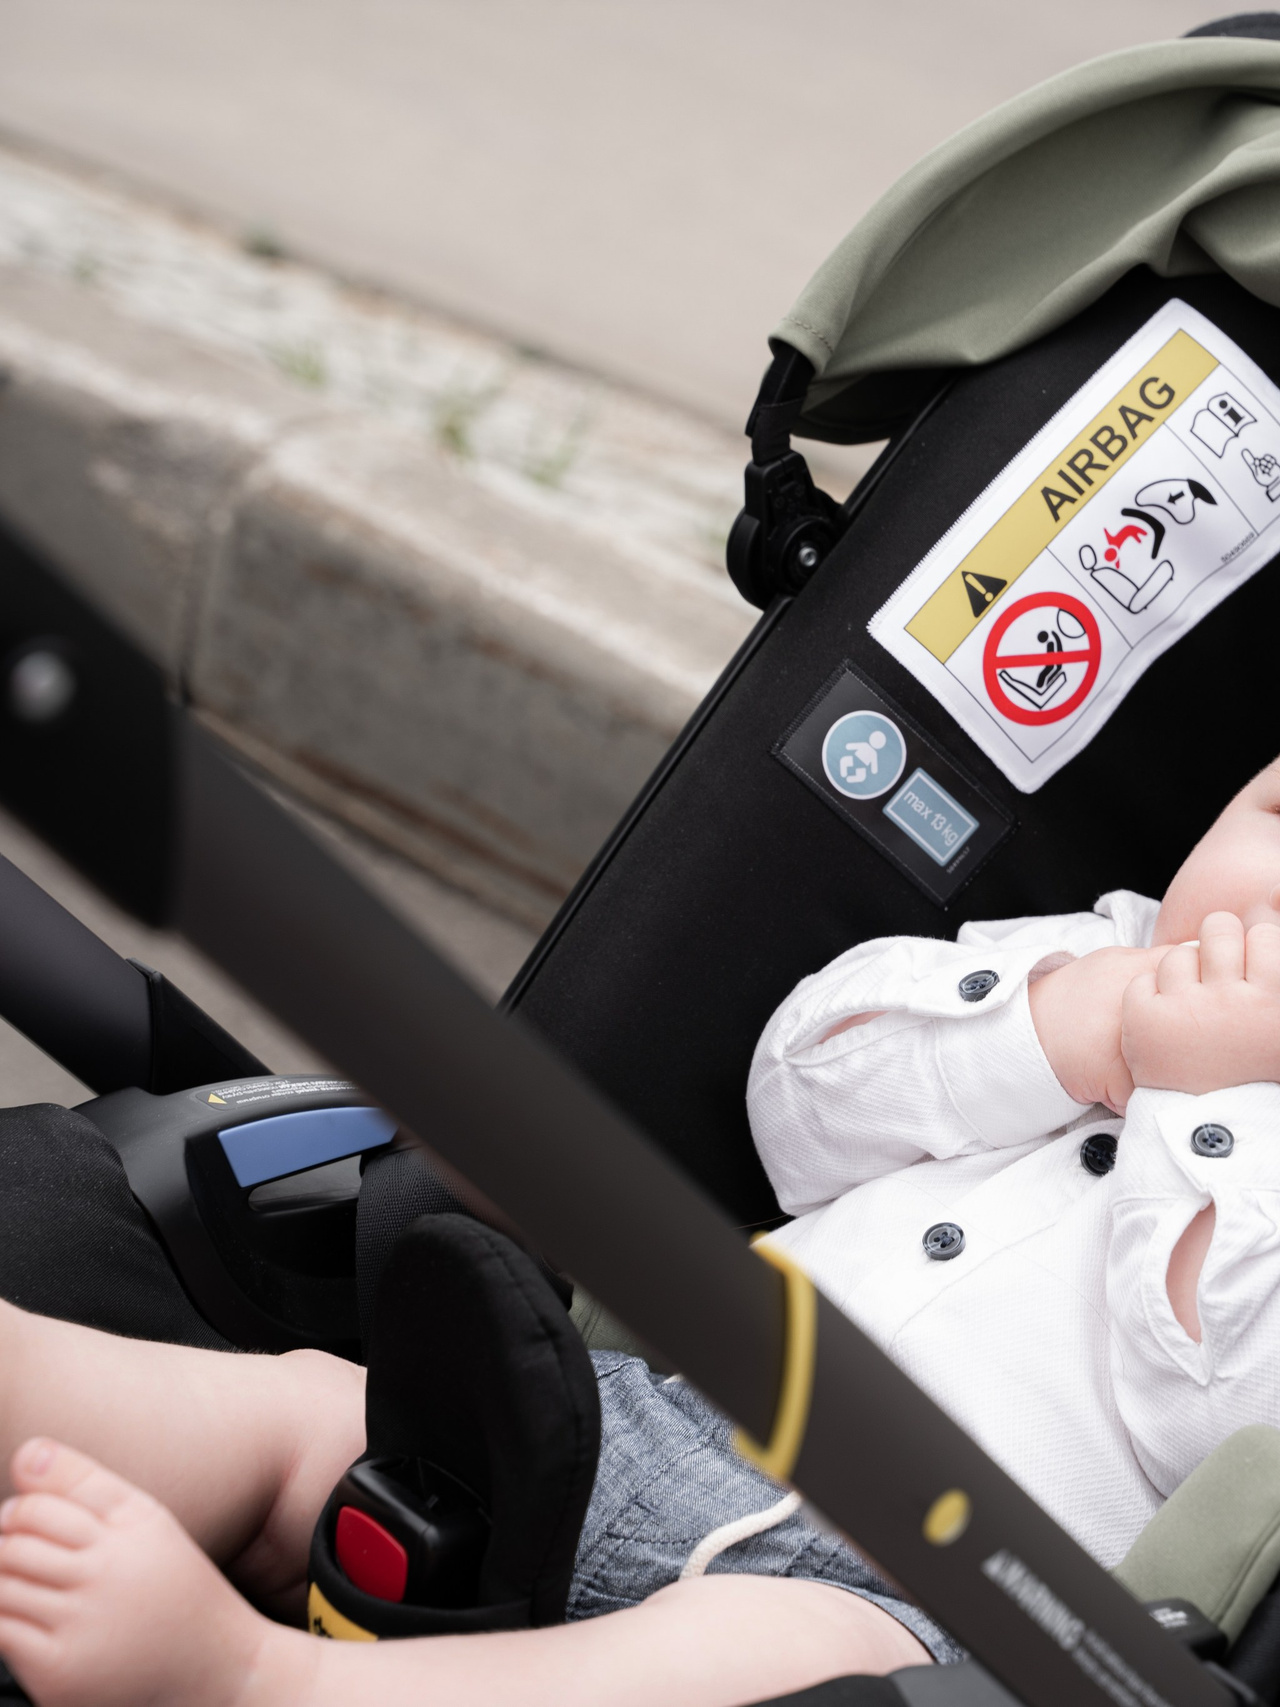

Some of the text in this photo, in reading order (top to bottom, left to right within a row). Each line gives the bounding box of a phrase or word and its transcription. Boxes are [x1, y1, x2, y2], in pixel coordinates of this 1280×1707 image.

[1040, 377, 1176, 523] AIRBAG
[903, 791, 958, 846] max 13 kg
